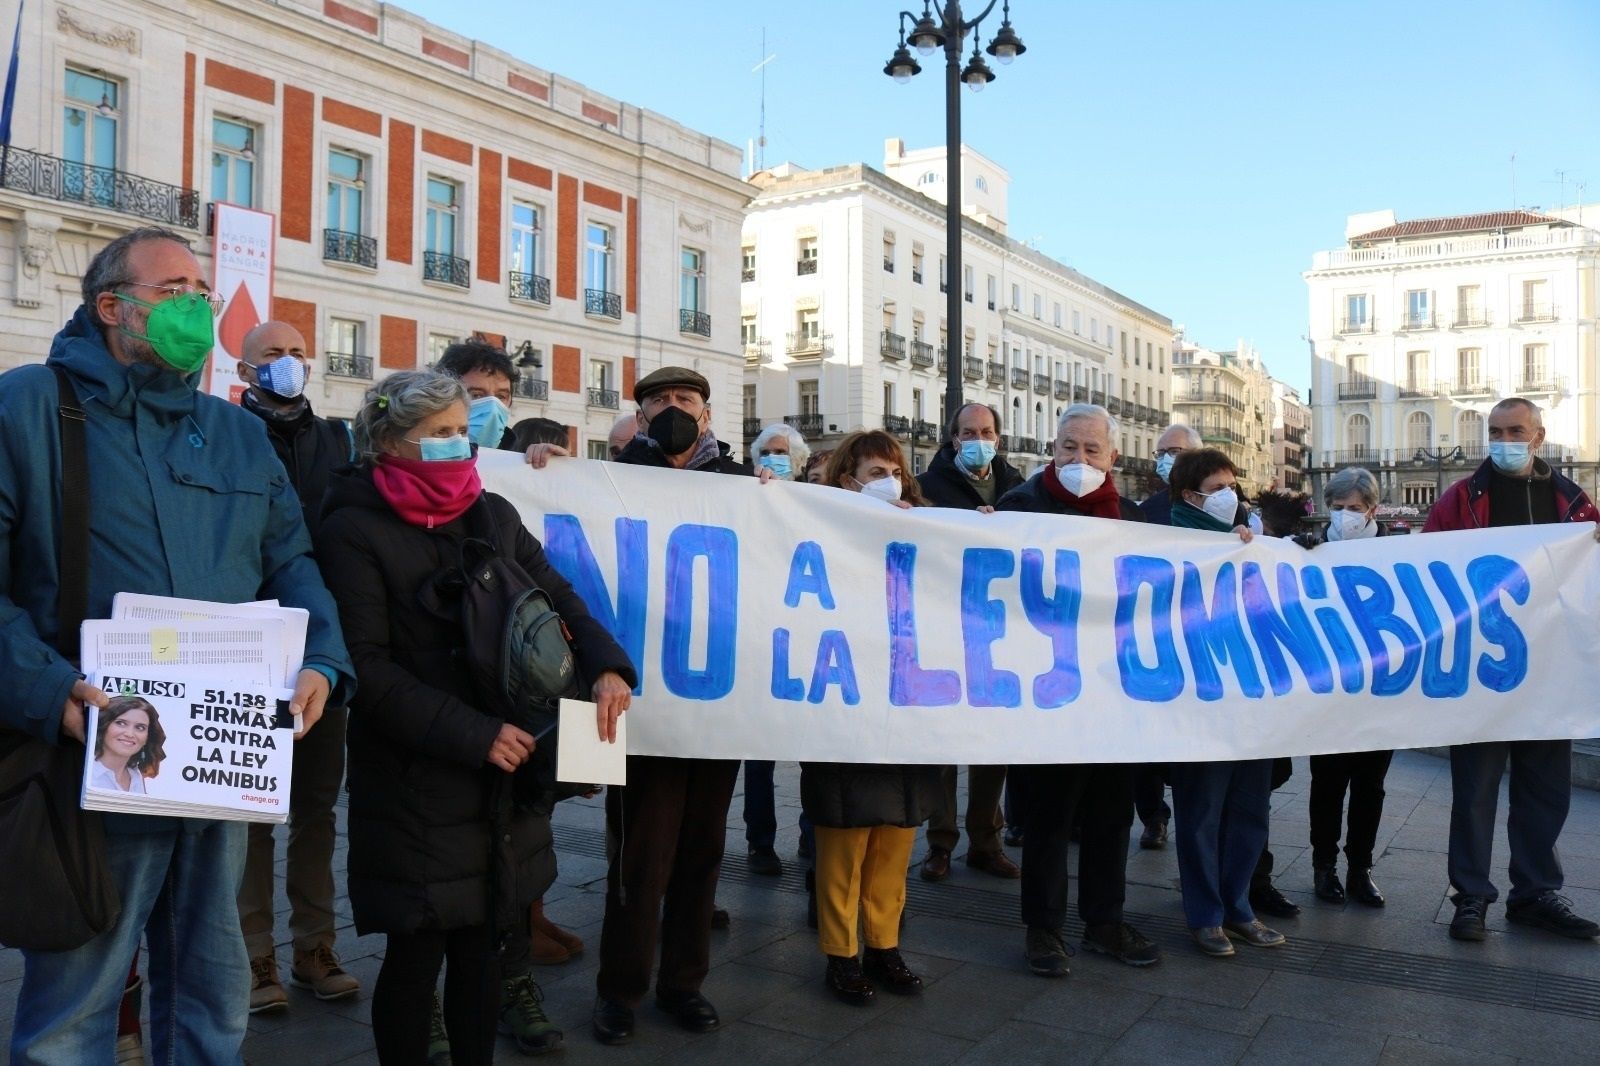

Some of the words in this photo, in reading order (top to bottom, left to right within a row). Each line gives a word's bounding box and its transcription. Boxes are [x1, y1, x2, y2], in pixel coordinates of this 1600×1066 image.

[221, 243, 266, 259] DONA
[221, 253, 266, 270] SANGRE
[784, 540, 836, 610] A
[543, 513, 739, 701] NO
[885, 541, 1082, 709] LEY
[771, 627, 860, 706] LA
[103, 676, 185, 698] ABUSO
[203, 689, 267, 710] 51.138
[190, 724, 277, 750] CONTRA
[196, 746, 224, 764] LA
[230, 750, 268, 769] LEY
[181, 765, 278, 792] OMNIBUS
[241, 793, 279, 805] change.org
